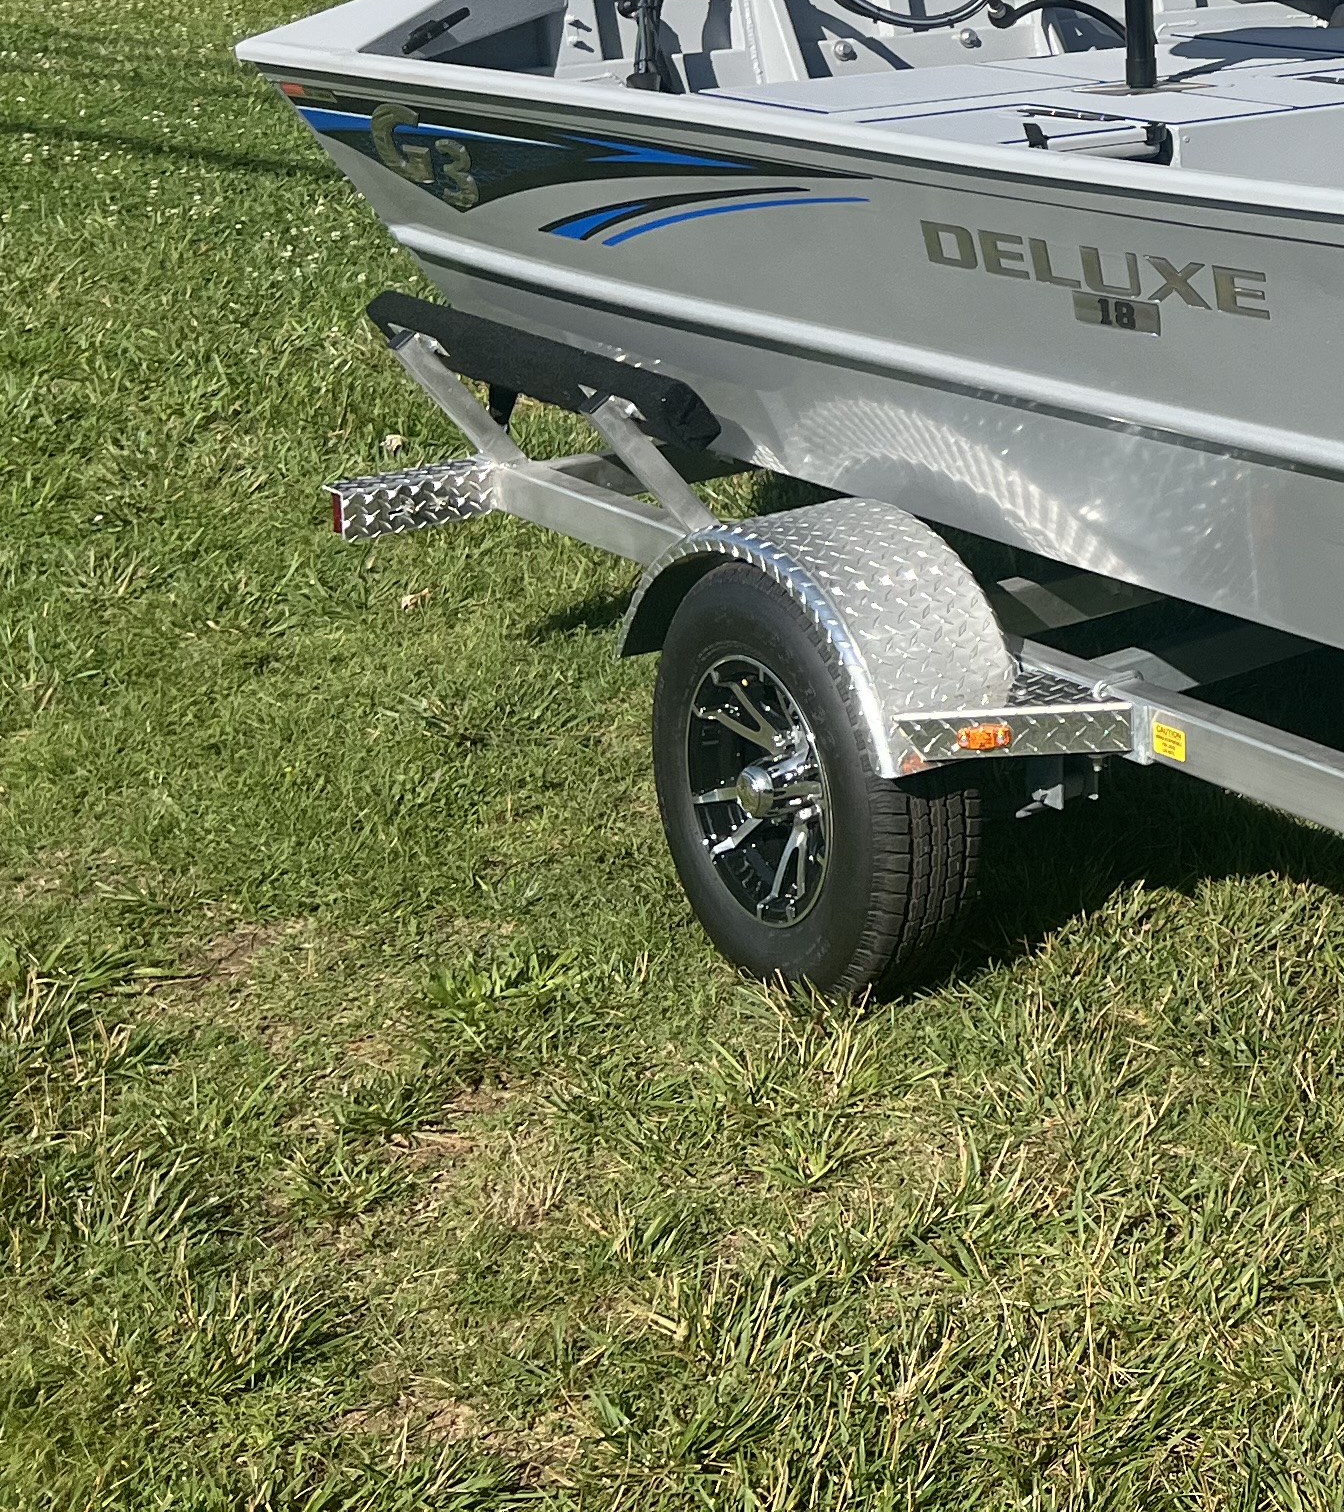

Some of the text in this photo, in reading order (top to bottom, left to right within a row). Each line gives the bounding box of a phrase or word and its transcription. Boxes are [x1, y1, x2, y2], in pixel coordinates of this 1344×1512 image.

[371, 102, 480, 210] G3
[919, 219, 1271, 320] DELUXE
[1097, 298, 1137, 330] 18
